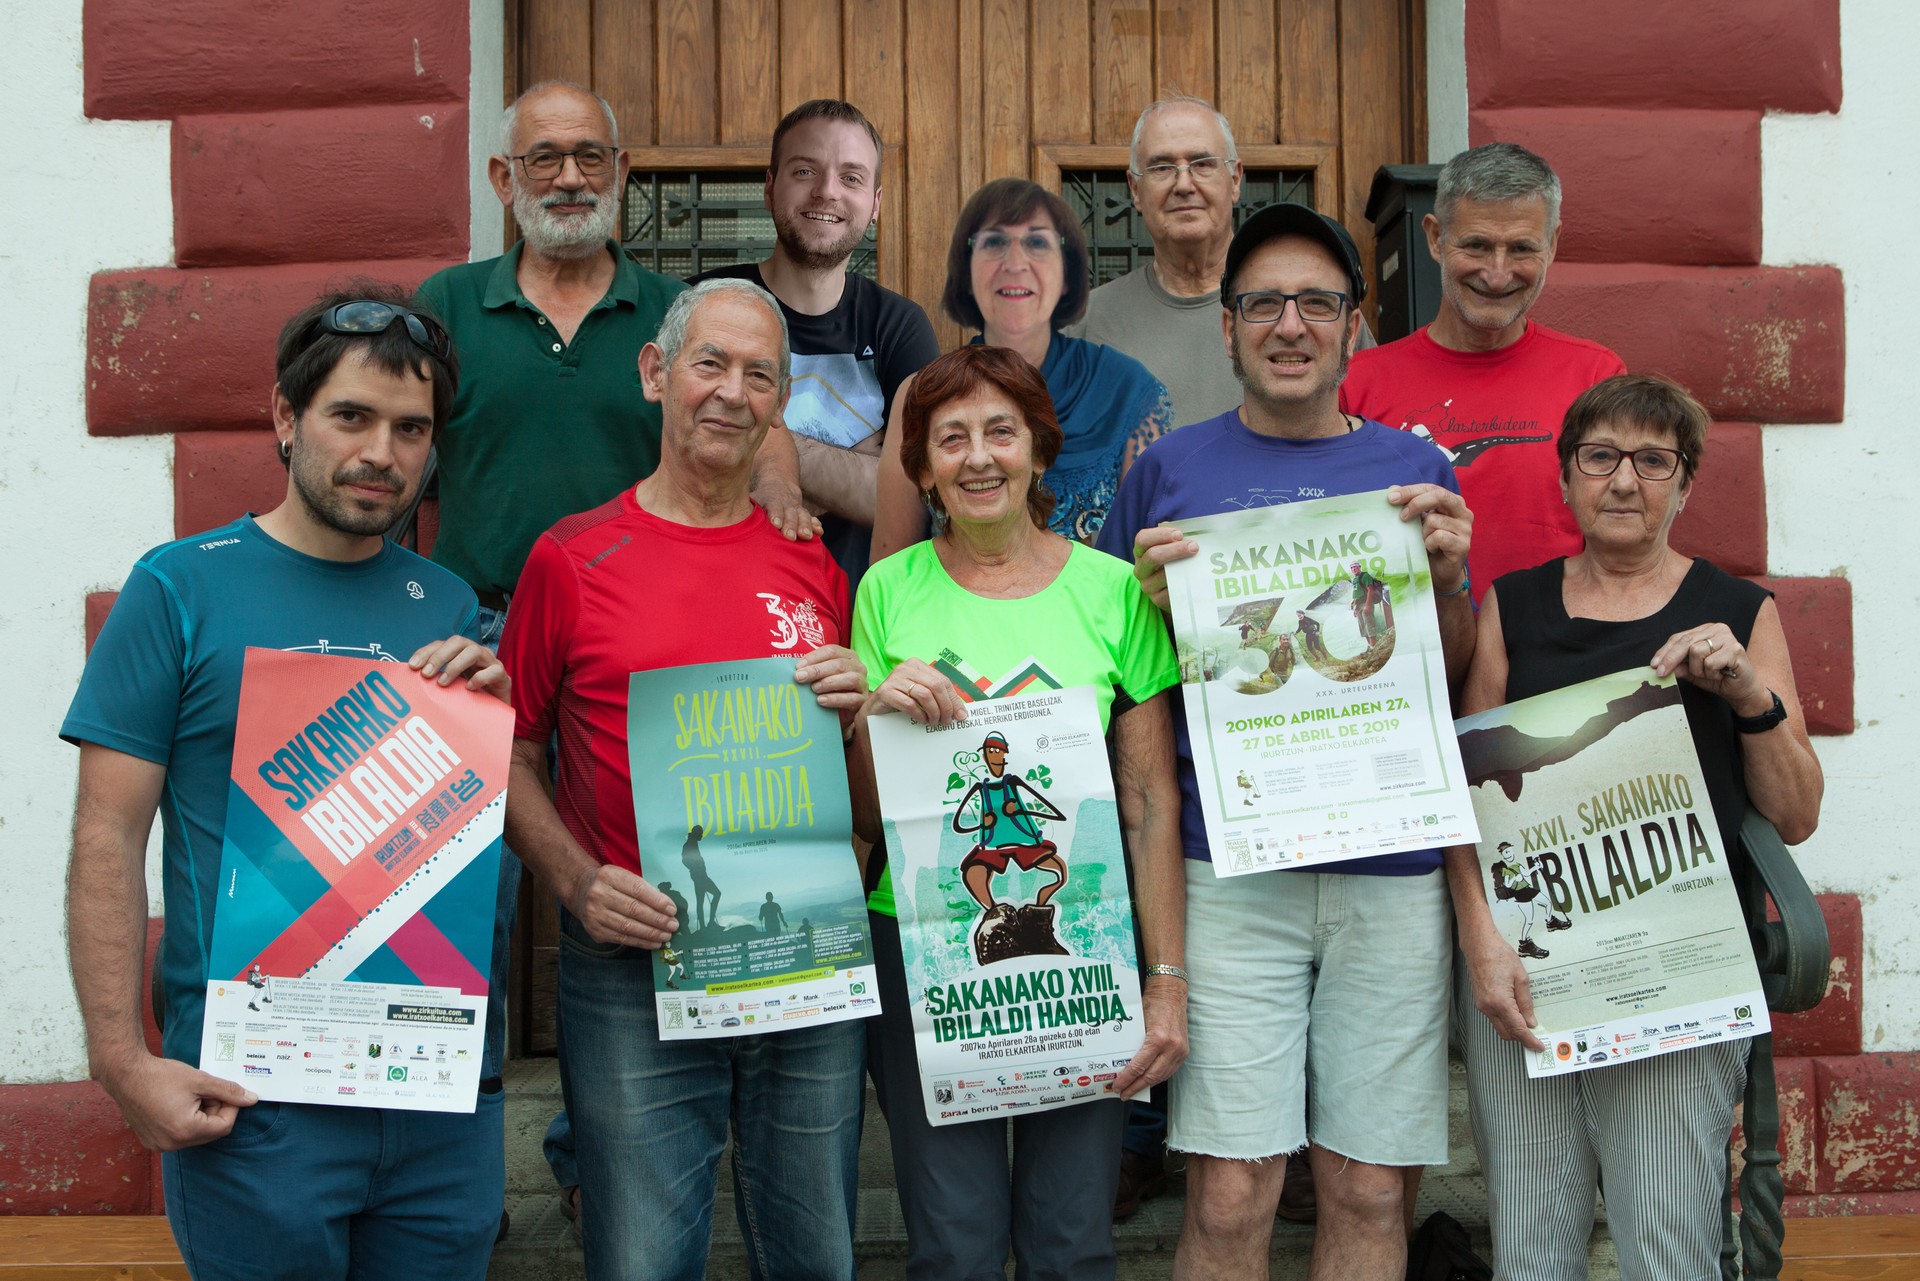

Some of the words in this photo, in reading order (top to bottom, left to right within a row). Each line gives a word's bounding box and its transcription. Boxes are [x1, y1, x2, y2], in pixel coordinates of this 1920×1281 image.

[1297, 486, 1325, 498] XXIX
[199, 537, 242, 552] TERNUA
[1209, 529, 1383, 576] SAKANAKO
[1214, 562, 1350, 599] IBILALDIA
[1315, 690, 1337, 698] XXX.
[1341, 681, 1396, 694] URTEURRENA
[673, 684, 803, 750] SAKANAKO
[956, 718, 983, 730] EUSKAL
[984, 714, 1013, 726] HERRIKO
[1013, 708, 1054, 721] ERDIGUNEA.
[970, 707, 994, 718] MIGEL.
[994, 702, 1027, 714] TRINITATE
[1027, 695, 1063, 708] BASELIZAK
[1225, 714, 1286, 734] 2019KO
[1290, 701, 1382, 725] APIRILAREN
[258, 669, 412, 812] SAKANAKO
[1242, 737, 1260, 751] 27
[1264, 733, 1284, 748] DE
[1290, 727, 1335, 745] ABRIL
[1338, 723, 1360, 738] DE
[1363, 718, 1400, 735] 2019
[722, 747, 767, 762] XXVII.
[1260, 746, 1305, 759] IRURTZUN
[1309, 741, 1341, 753] IRATXO
[1342, 736, 1387, 749] ELKARTEA
[301, 715, 463, 867] IBILALDIA
[449, 769, 485, 803] 30
[427, 798, 451, 823] ABRIL
[680, 765, 815, 840] IBILALDIA
[1519, 815, 1575, 853] XXVI.
[1577, 773, 1693, 836] SAKANAKO
[415, 808, 441, 834] 2022
[373, 826, 415, 865] IRURTZUN
[1526, 812, 1715, 914] IBILALDIA
[1672, 876, 1714, 894] IRURTZUN
[711, 979, 774, 993] www.iratxoelkartea.com
[927, 969, 1064, 1016] SAKANAKO
[1068, 963, 1120, 996] XVIII.
[1605, 985, 1667, 1003] www.iratxoelkartea.com
[392, 1012, 468, 1024] www.iratxoelkartea.com
[402, 1006, 462, 1017] www.zirkuitua.com
[933, 1005, 1032, 1043] IBILALDI
[1037, 993, 1130, 1031] HANDIA
[960, 1041, 987, 1053] 2007ko
[988, 1037, 1023, 1050] Apirilaren
[1024, 1034, 1038, 1044] 28a
[1039, 1032, 1067, 1044] goizeko
[1067, 1029, 1083, 1039] 6:00
[1084, 1027, 1101, 1036] etan
[1698, 1031, 1723, 1042] beleixe
[978, 1049, 1004, 1061] IRATXO
[1005, 1044, 1046, 1057] ELKARTEAN
[1047, 1039, 1085, 1052] IRURTZUN.
[998, 1084, 1027, 1092] LABORAL
[971, 1104, 999, 1115] berria
